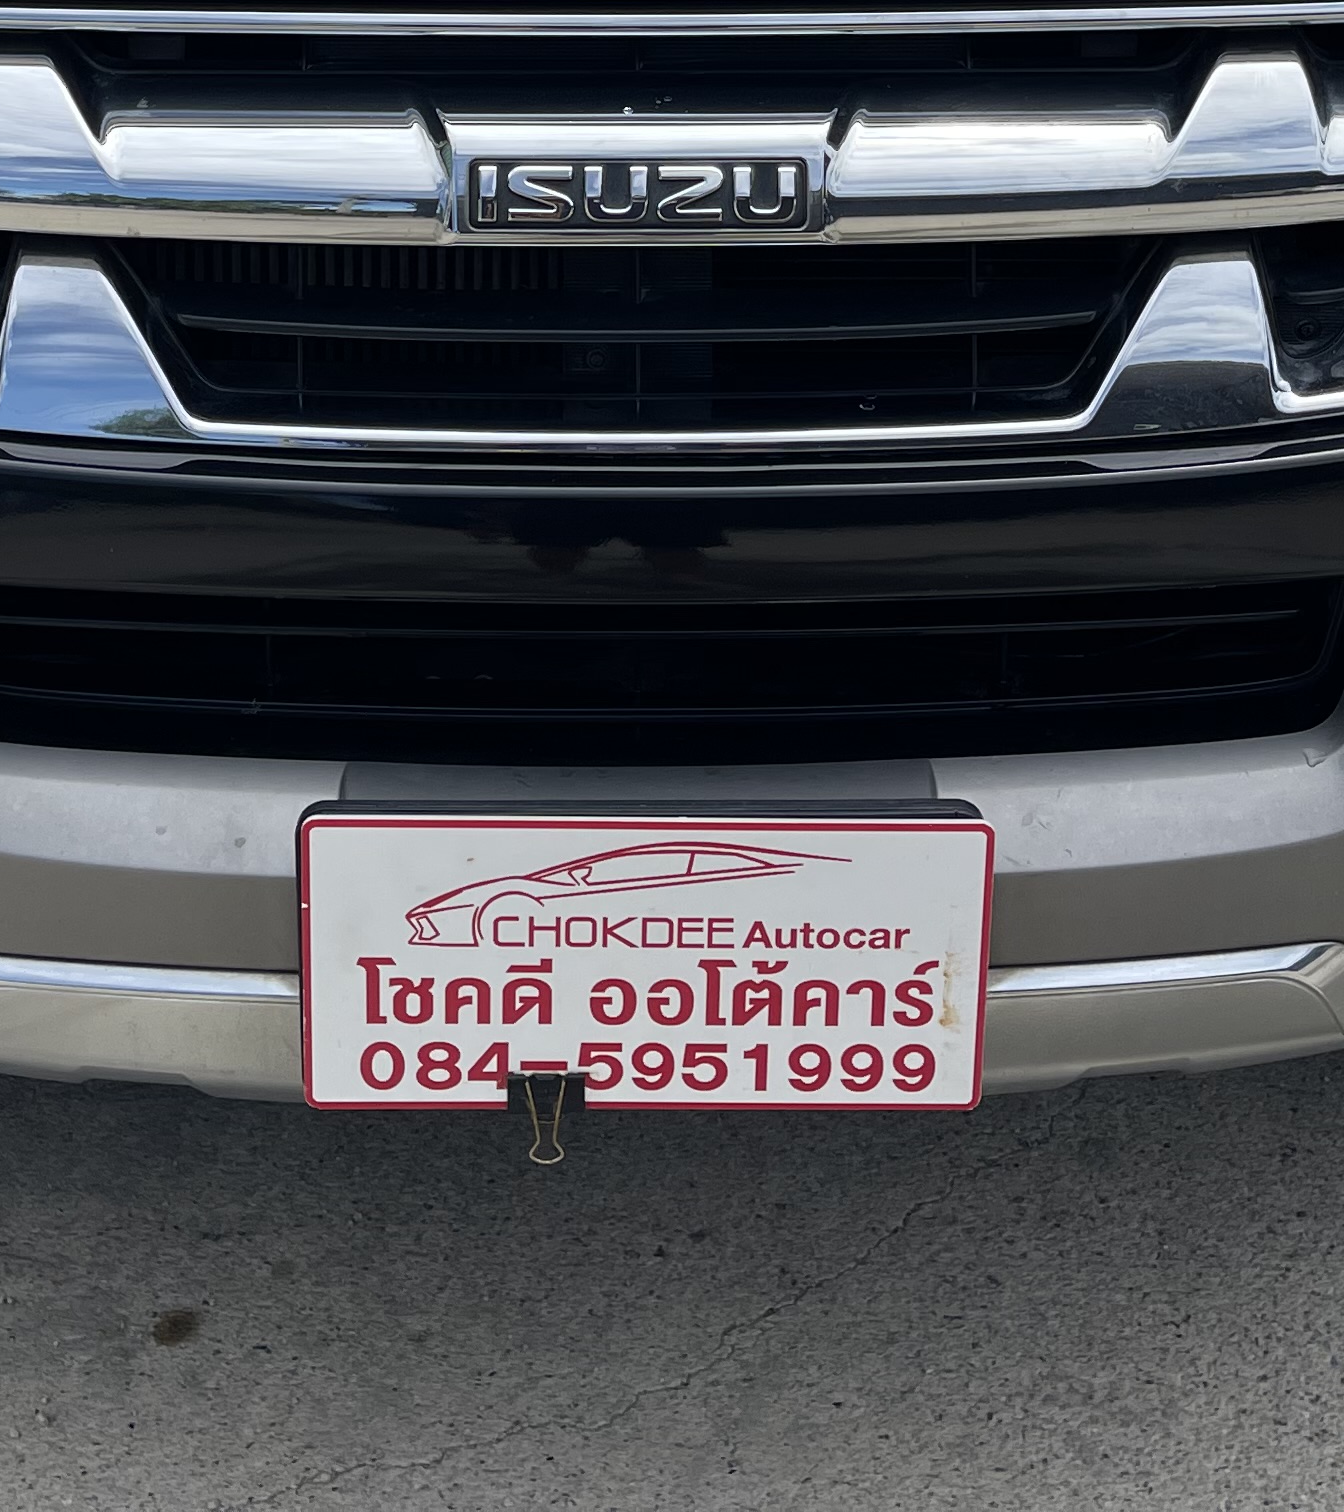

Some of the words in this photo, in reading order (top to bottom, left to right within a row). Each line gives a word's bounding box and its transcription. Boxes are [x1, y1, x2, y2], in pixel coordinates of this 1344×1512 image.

[476, 164, 798, 223] ISUZU
[492, 916, 735, 949] CHOKDEE
[742, 920, 911, 950] Autocar
[356, 957, 553, 1026] โชคดี
[589, 959, 939, 1027] ออโต้คาร์
[359, 1041, 936, 1092] 084-5951999
